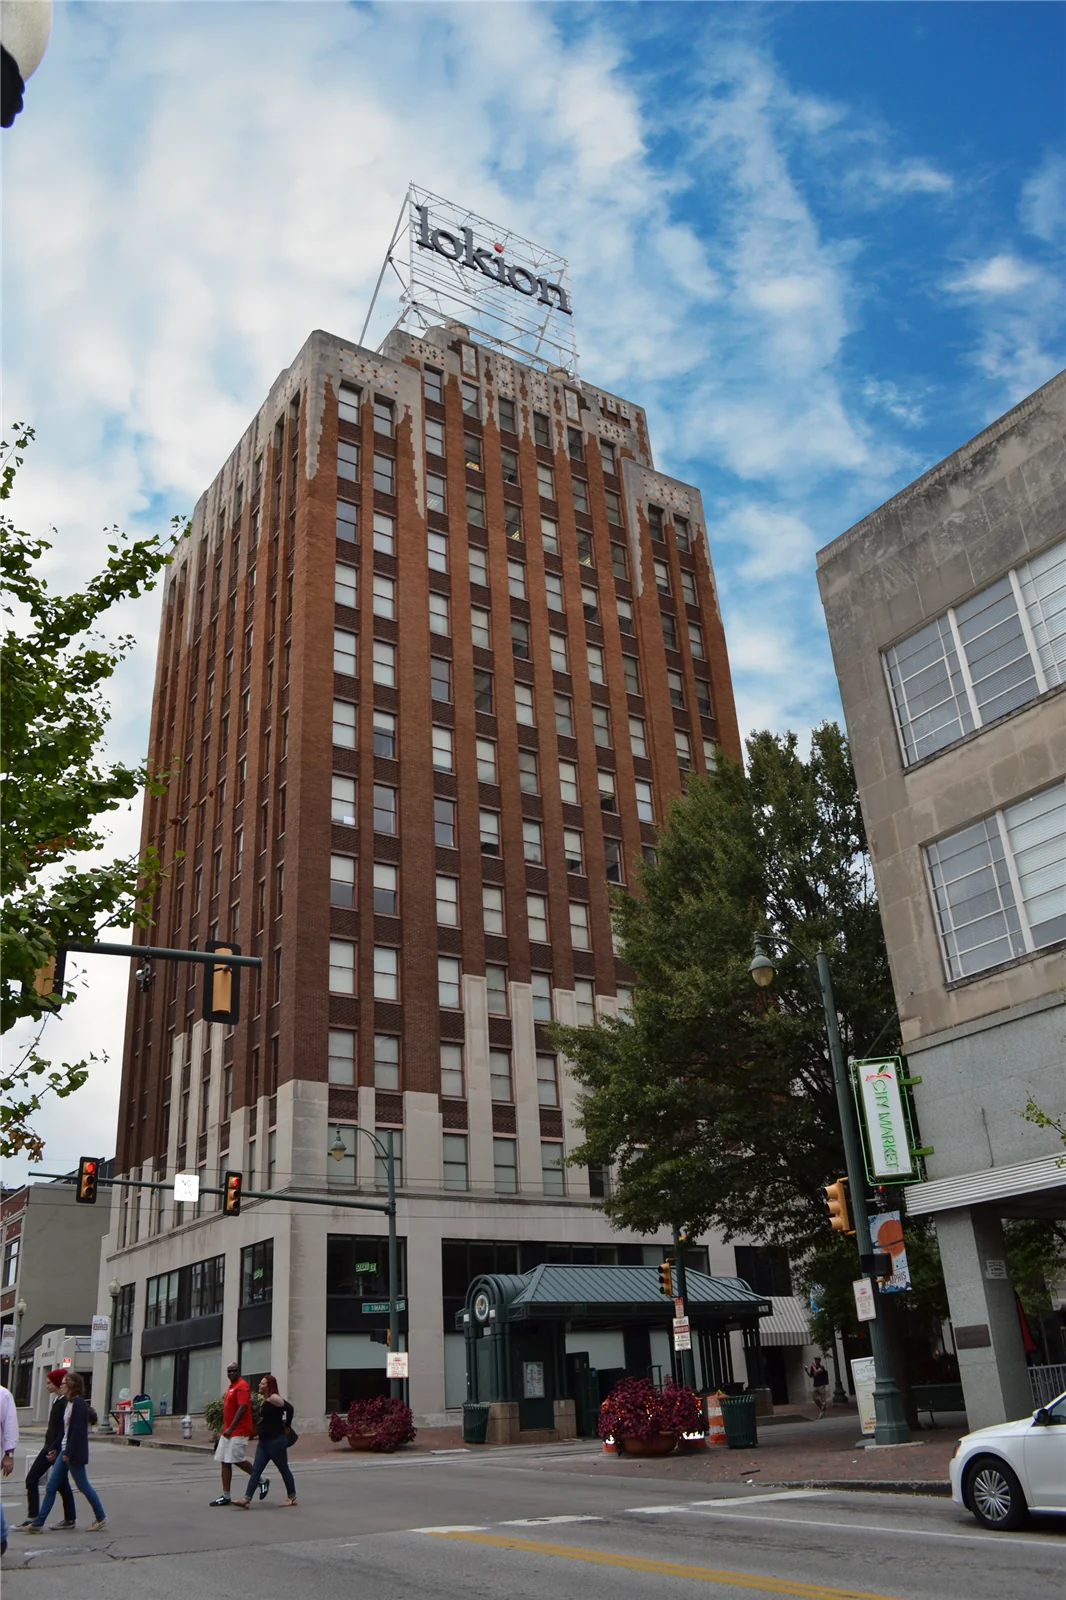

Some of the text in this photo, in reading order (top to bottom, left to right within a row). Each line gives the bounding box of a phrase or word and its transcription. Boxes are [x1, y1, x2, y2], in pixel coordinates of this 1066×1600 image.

[416, 205, 573, 315] lokion
[873, 1079, 889, 1108] CITY
[878, 1112, 899, 1167] MARKET
